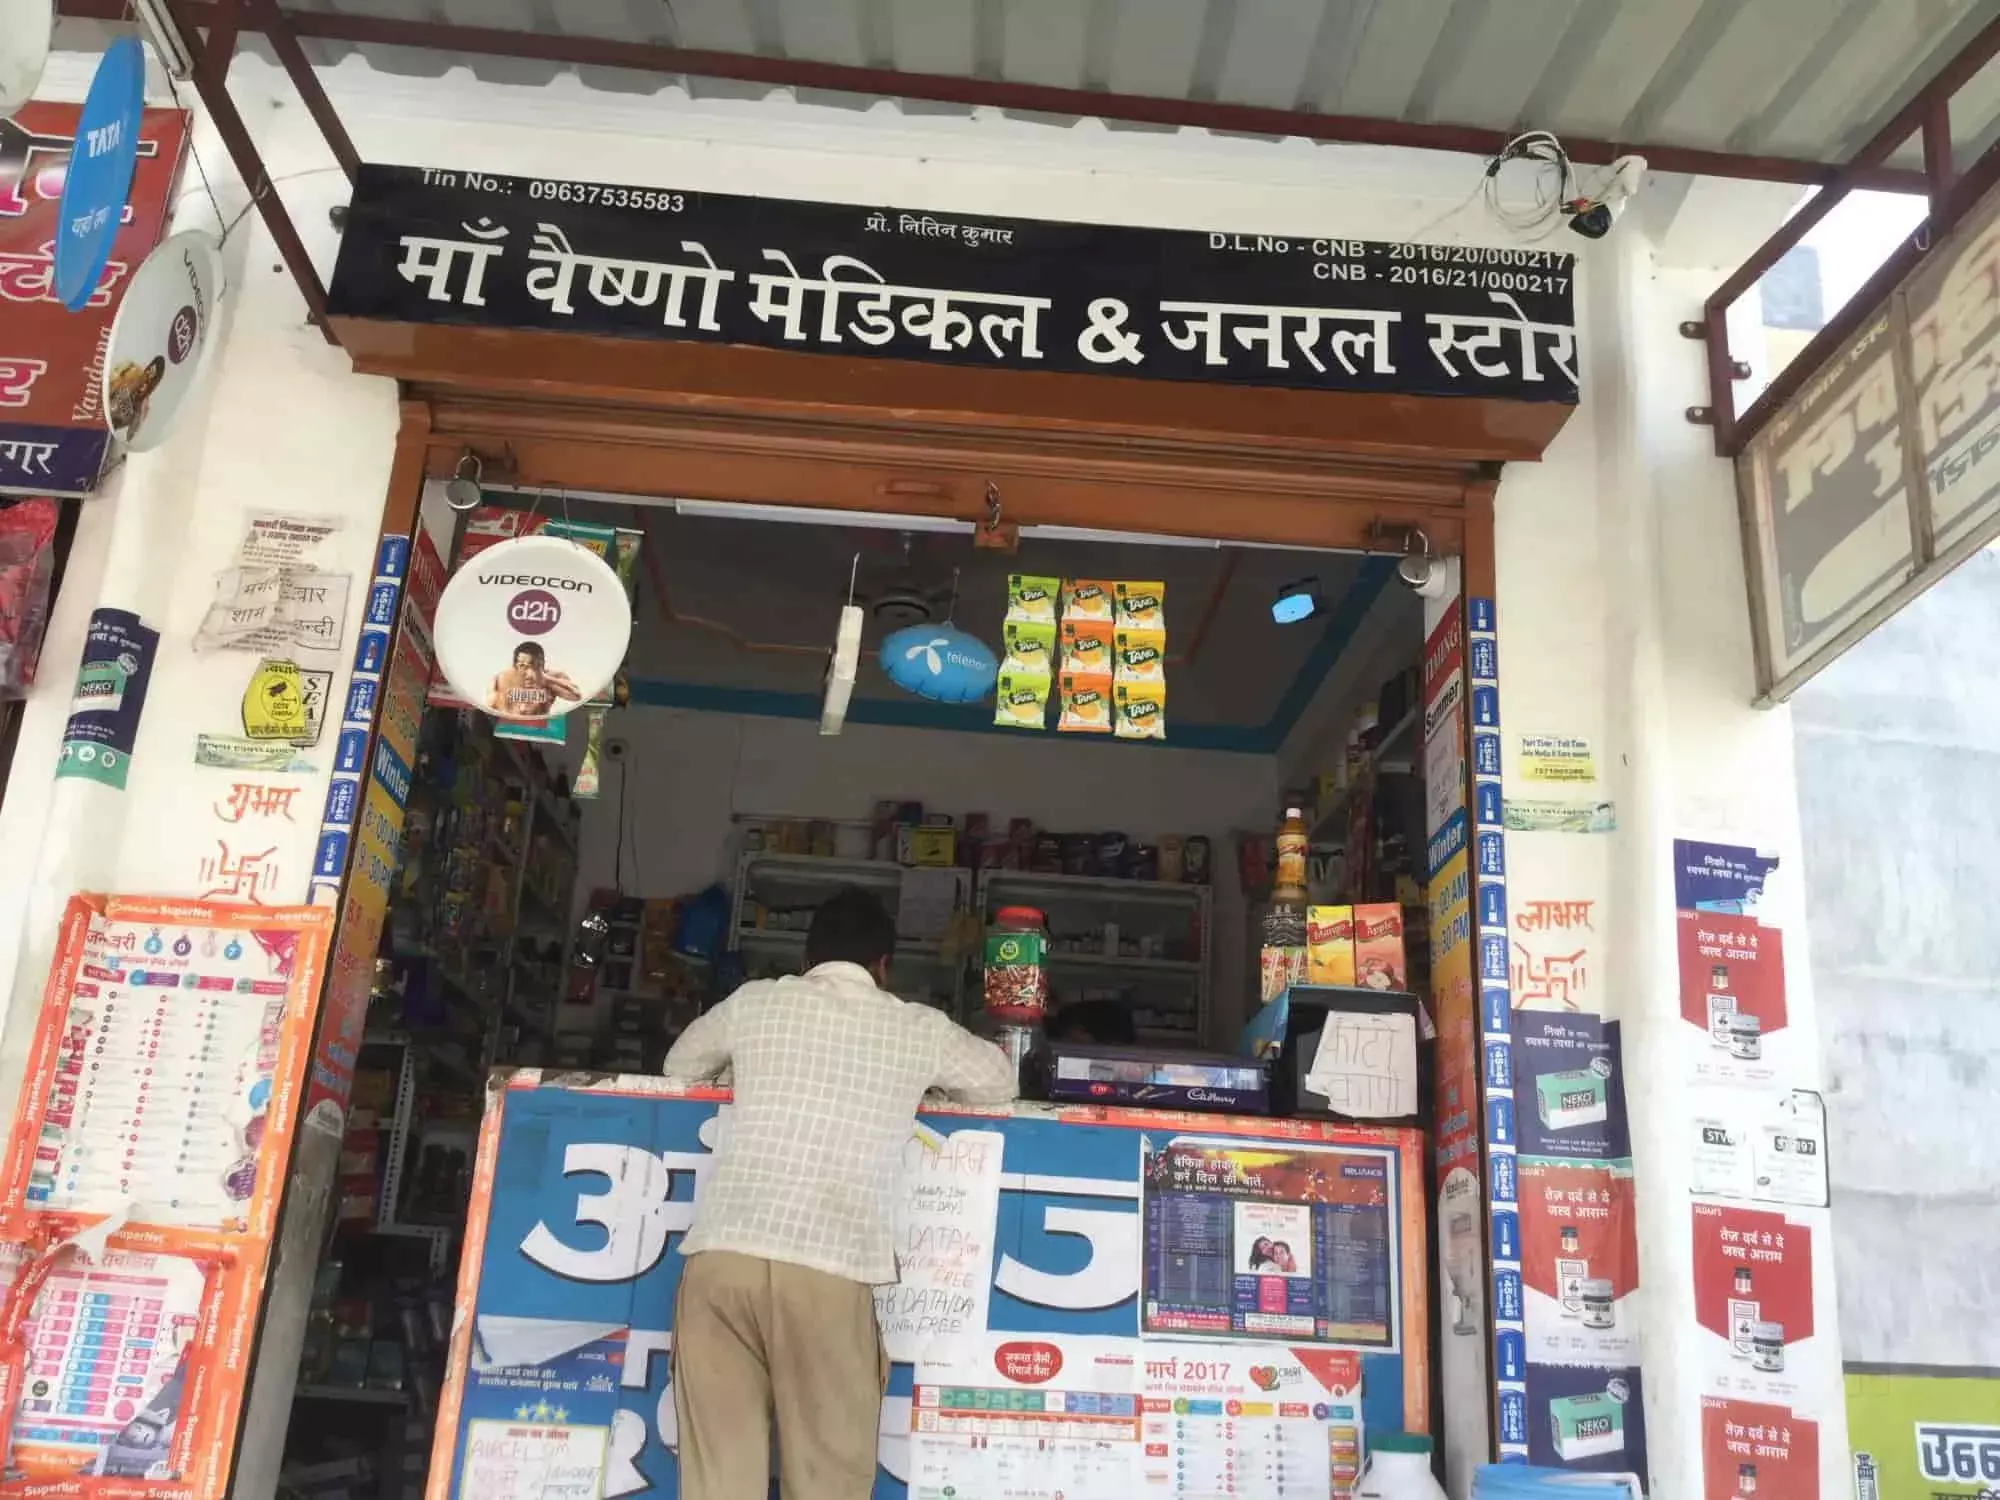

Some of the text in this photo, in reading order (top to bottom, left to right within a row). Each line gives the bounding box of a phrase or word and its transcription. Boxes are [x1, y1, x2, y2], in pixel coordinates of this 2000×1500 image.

[421, 167, 456, 188] Tin
[528, 180, 685, 213] 09637535583
[1312, 239, 1365, 259] CNB
[1312, 262, 1367, 282] CNB
[1390, 266, 1569, 295] 2016/21/000217
[397, 215, 1580, 388] माँ वैष्णो मेडिकल & जनरल स्टोर
[478, 574, 593, 594] VIDEOCON
[511, 600, 558, 623] d2h
[375, 743, 410, 804] Winter
[1428, 820, 1463, 873] Winter
[1366, 919, 1394, 937] Apple
[1186, 1087, 1237, 1105] Cadbury
[1562, 1090, 1593, 1106] NEKO
[1145, 1356, 1232, 1381] मार्च 2017
[1577, 1416, 1609, 1434] NEKO
